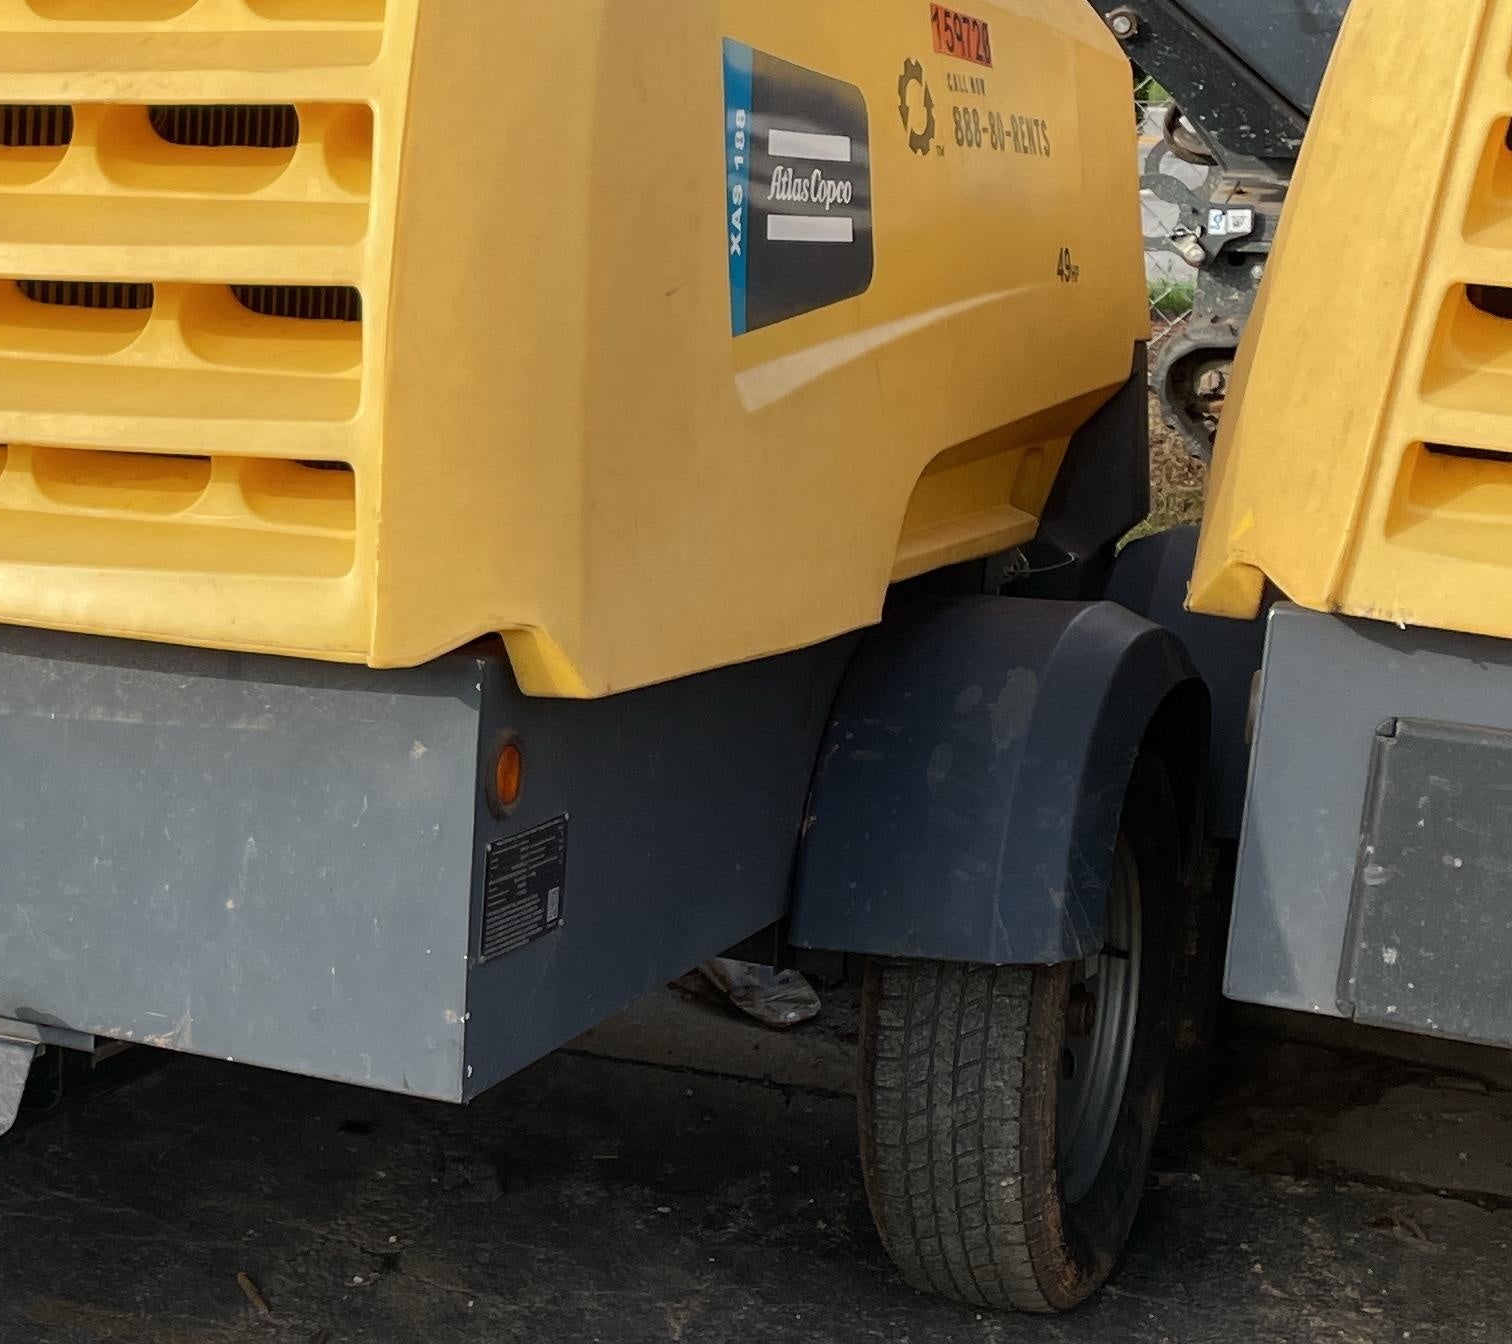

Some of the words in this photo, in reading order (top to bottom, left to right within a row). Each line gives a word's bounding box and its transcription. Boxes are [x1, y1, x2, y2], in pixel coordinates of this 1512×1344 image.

[932, 9, 992, 65] 159720
[947, 72, 969, 94] CALL
[953, 106, 1050, 156] 888-80-RENTS
[767, 165, 810, 202] Atlas
[810, 168, 852, 211] Copco
[730, 184, 743, 257] XAS
